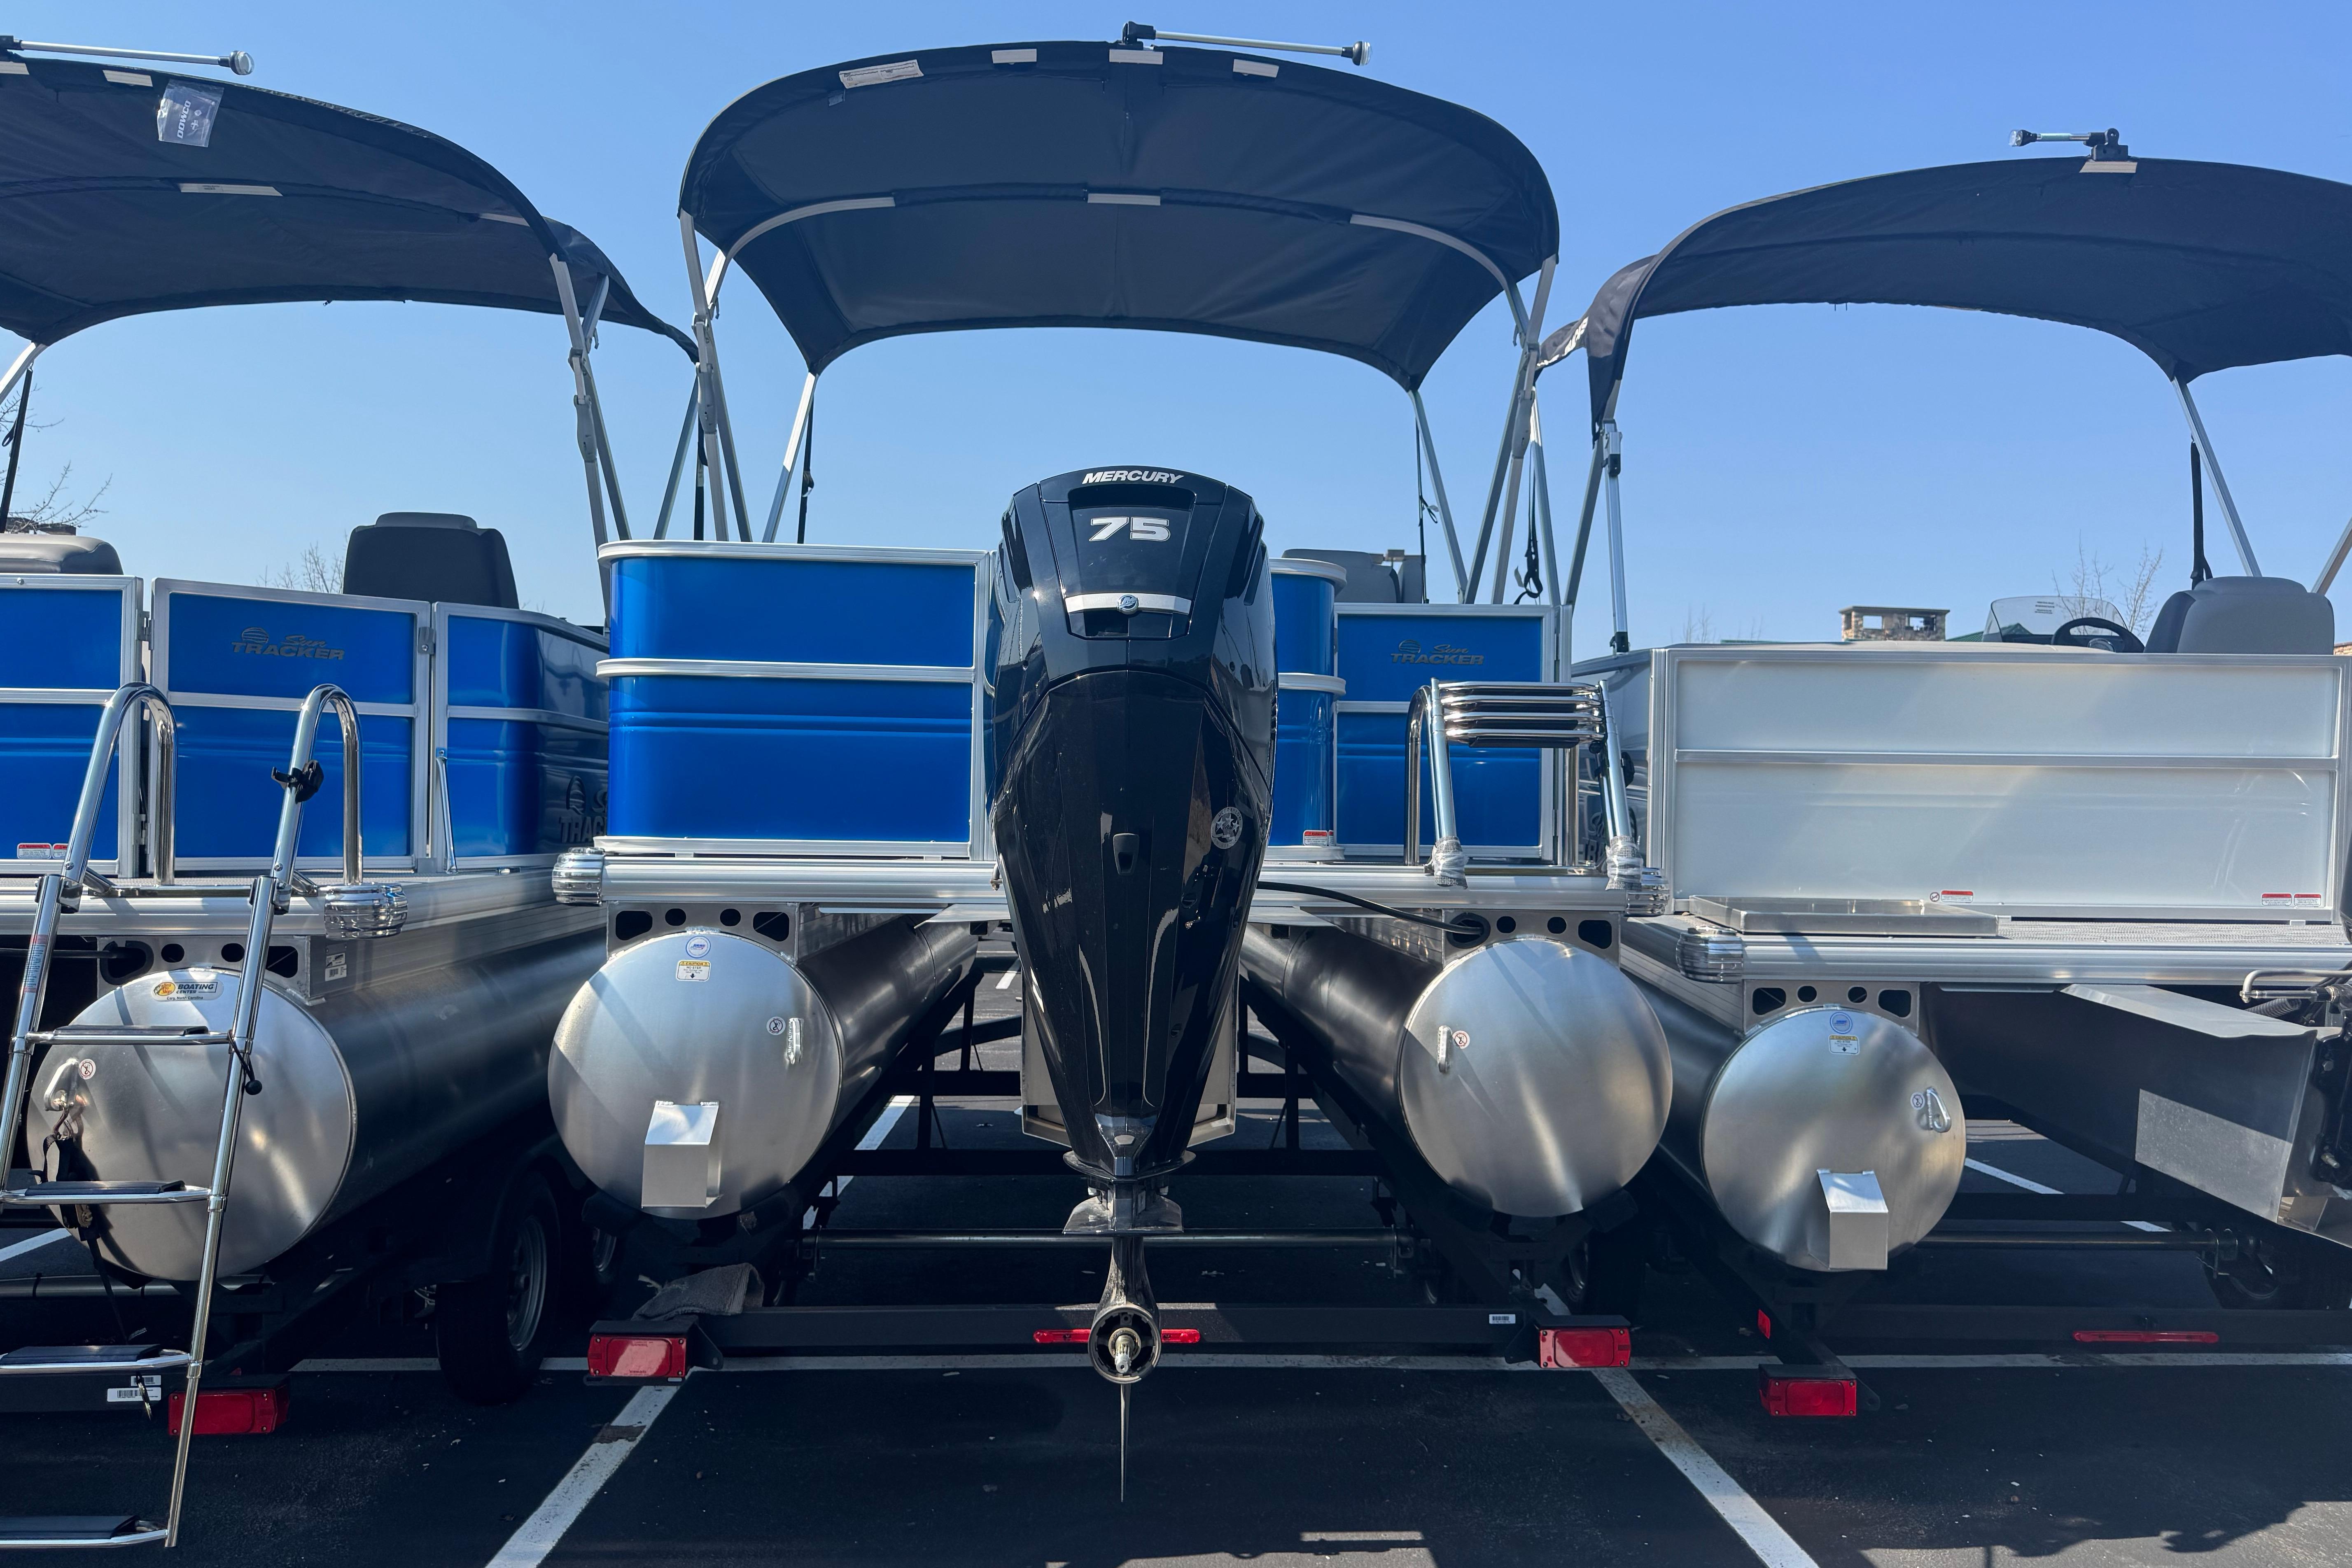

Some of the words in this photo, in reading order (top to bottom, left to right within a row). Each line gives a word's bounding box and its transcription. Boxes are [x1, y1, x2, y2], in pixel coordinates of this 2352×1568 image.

[177, 100, 191, 139] DOWCO
[1082, 470, 1184, 484] MERCURY
[1089, 516, 1171, 541] 75
[280, 635, 327, 647] Sun
[231, 642, 345, 660] TRACKER
[1429, 644, 1469, 654] Sun
[1391, 653, 1484, 665] TRACKER
